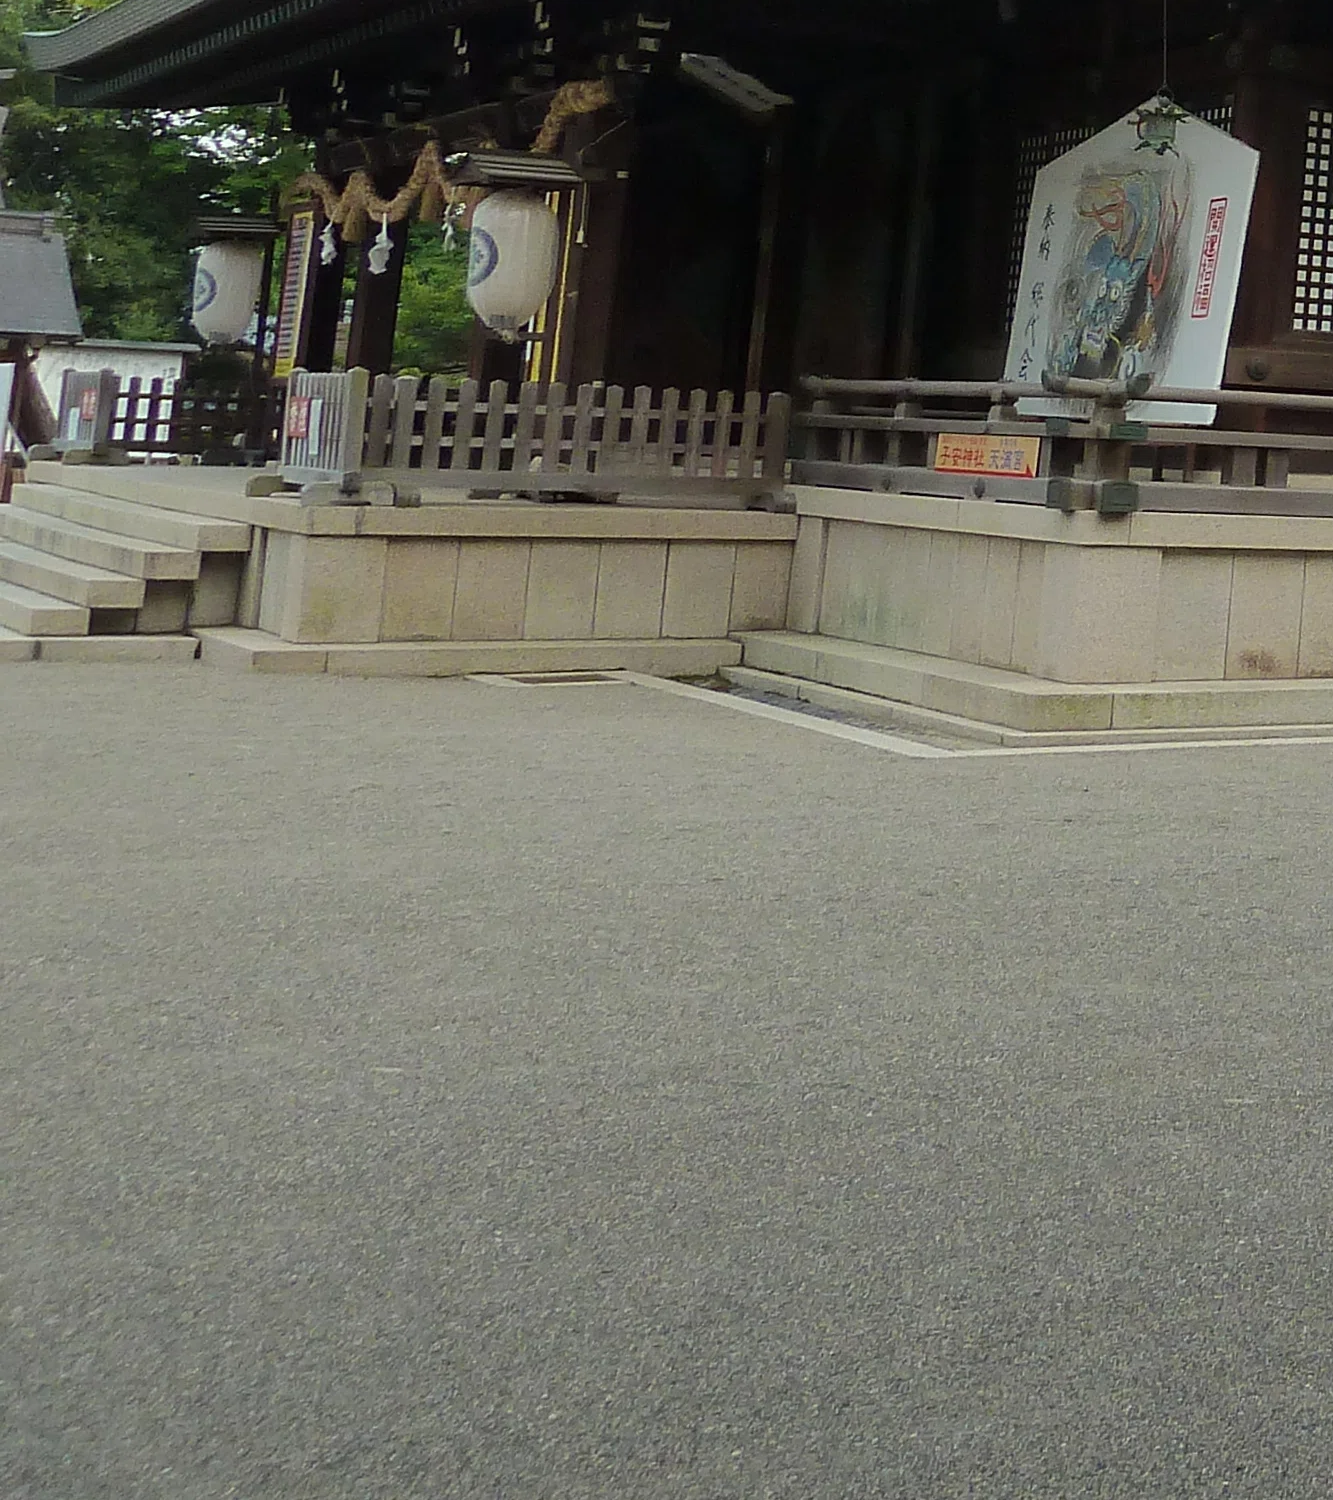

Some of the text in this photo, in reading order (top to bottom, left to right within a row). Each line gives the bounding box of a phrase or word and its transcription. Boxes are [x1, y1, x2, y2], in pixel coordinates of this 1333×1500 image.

[940, 445, 1025, 471] 子安神社 天満宮
